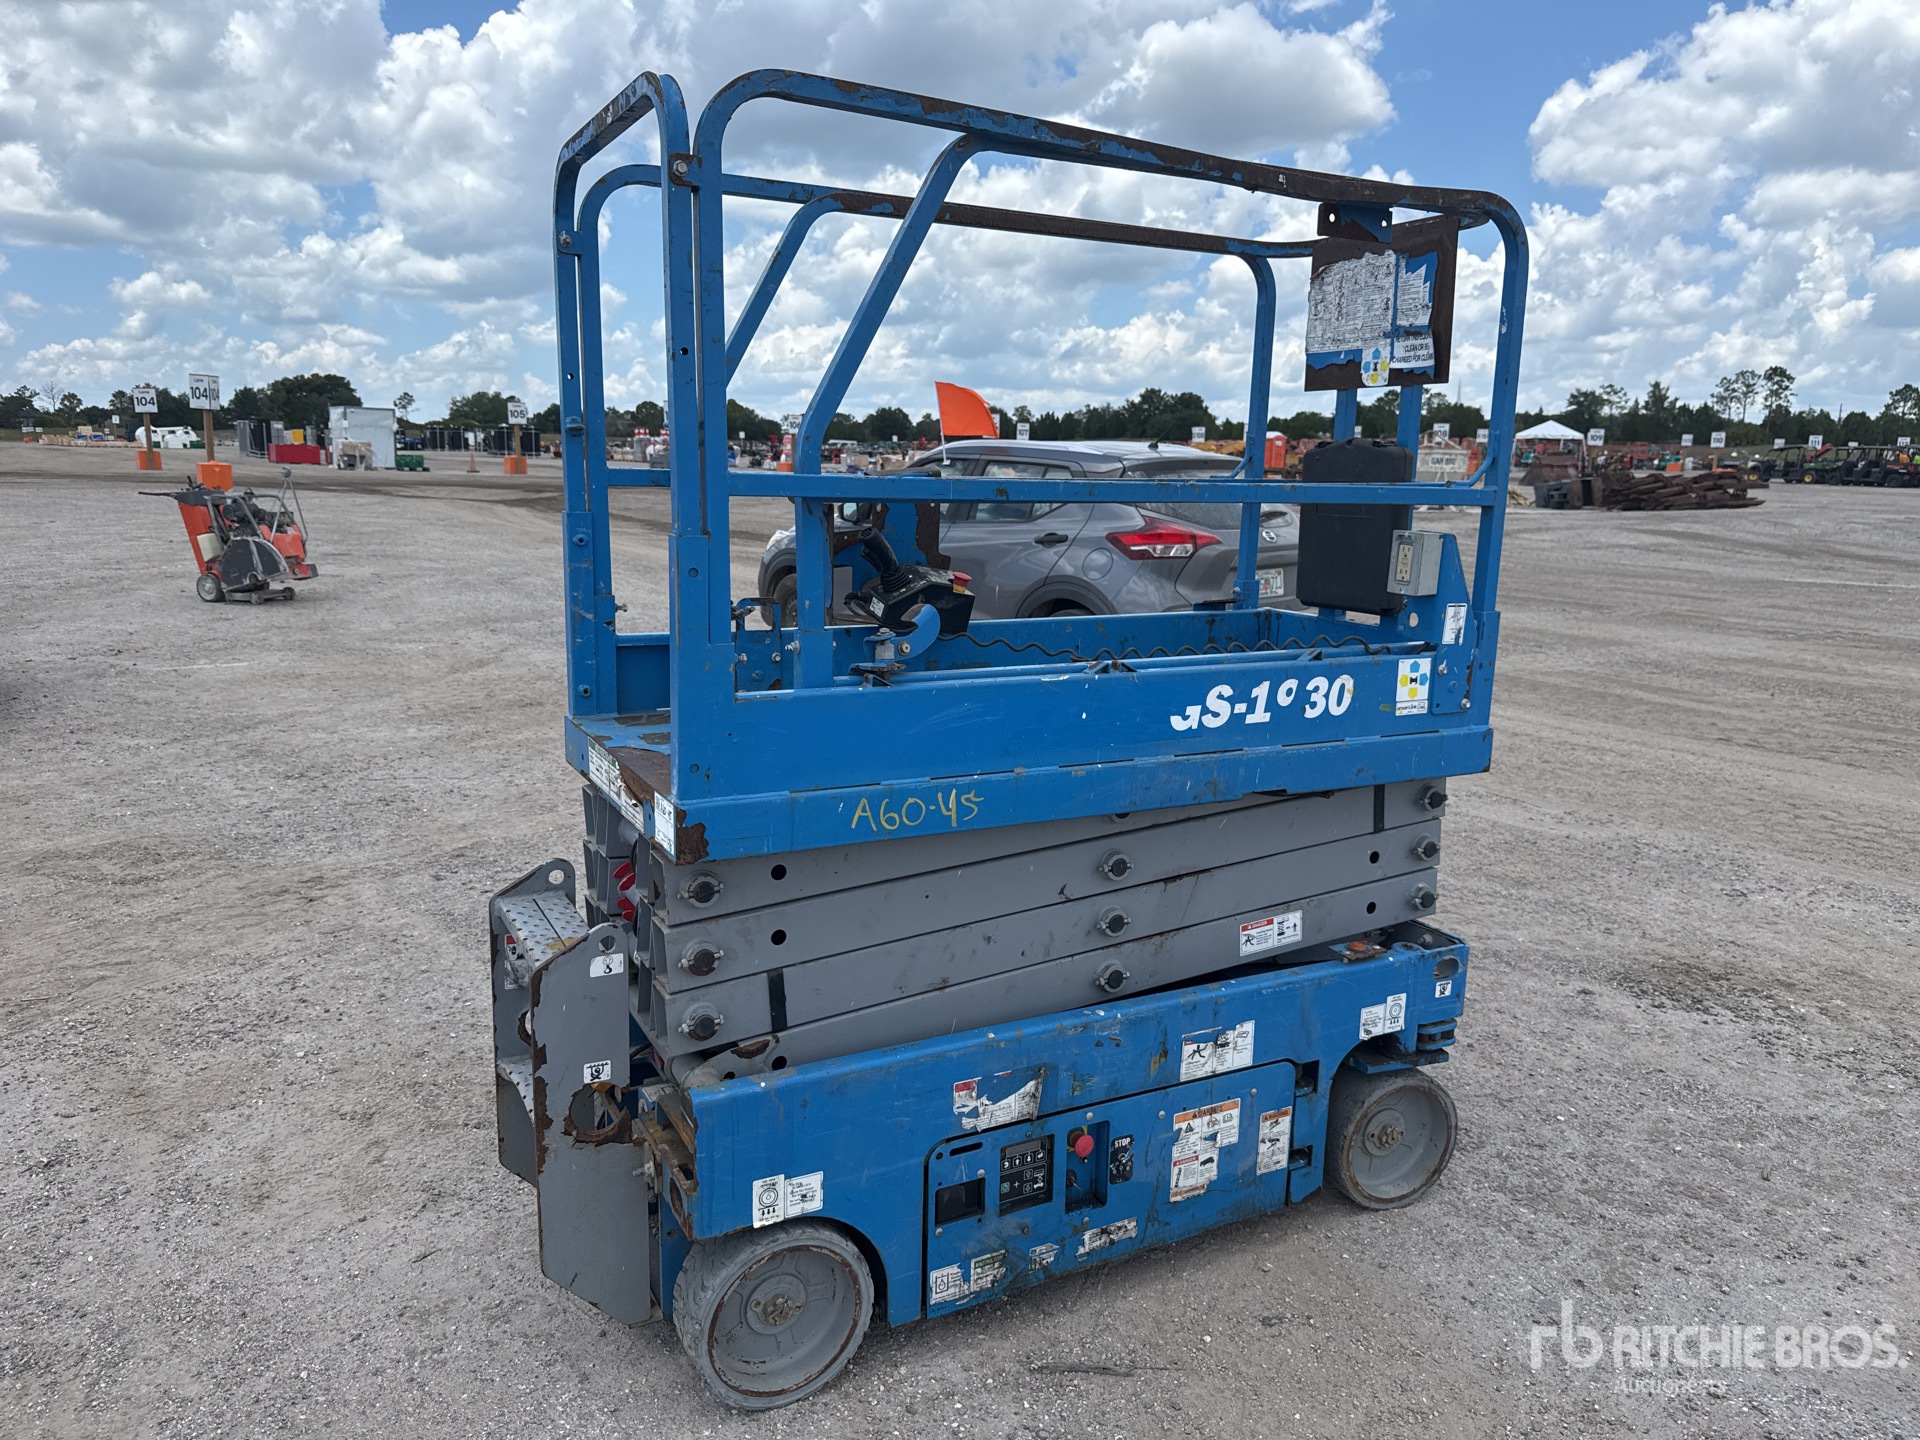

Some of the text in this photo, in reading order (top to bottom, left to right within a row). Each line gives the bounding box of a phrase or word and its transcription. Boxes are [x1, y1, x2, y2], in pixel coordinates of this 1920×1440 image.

[189, 386, 208, 400] 104
[135, 396, 155, 407] 104
[509, 409, 526, 419] 105
[1590, 434, 1603, 442] 109
[850, 787, 985, 832] A60-45
[1114, 1137, 1131, 1148] STOP
